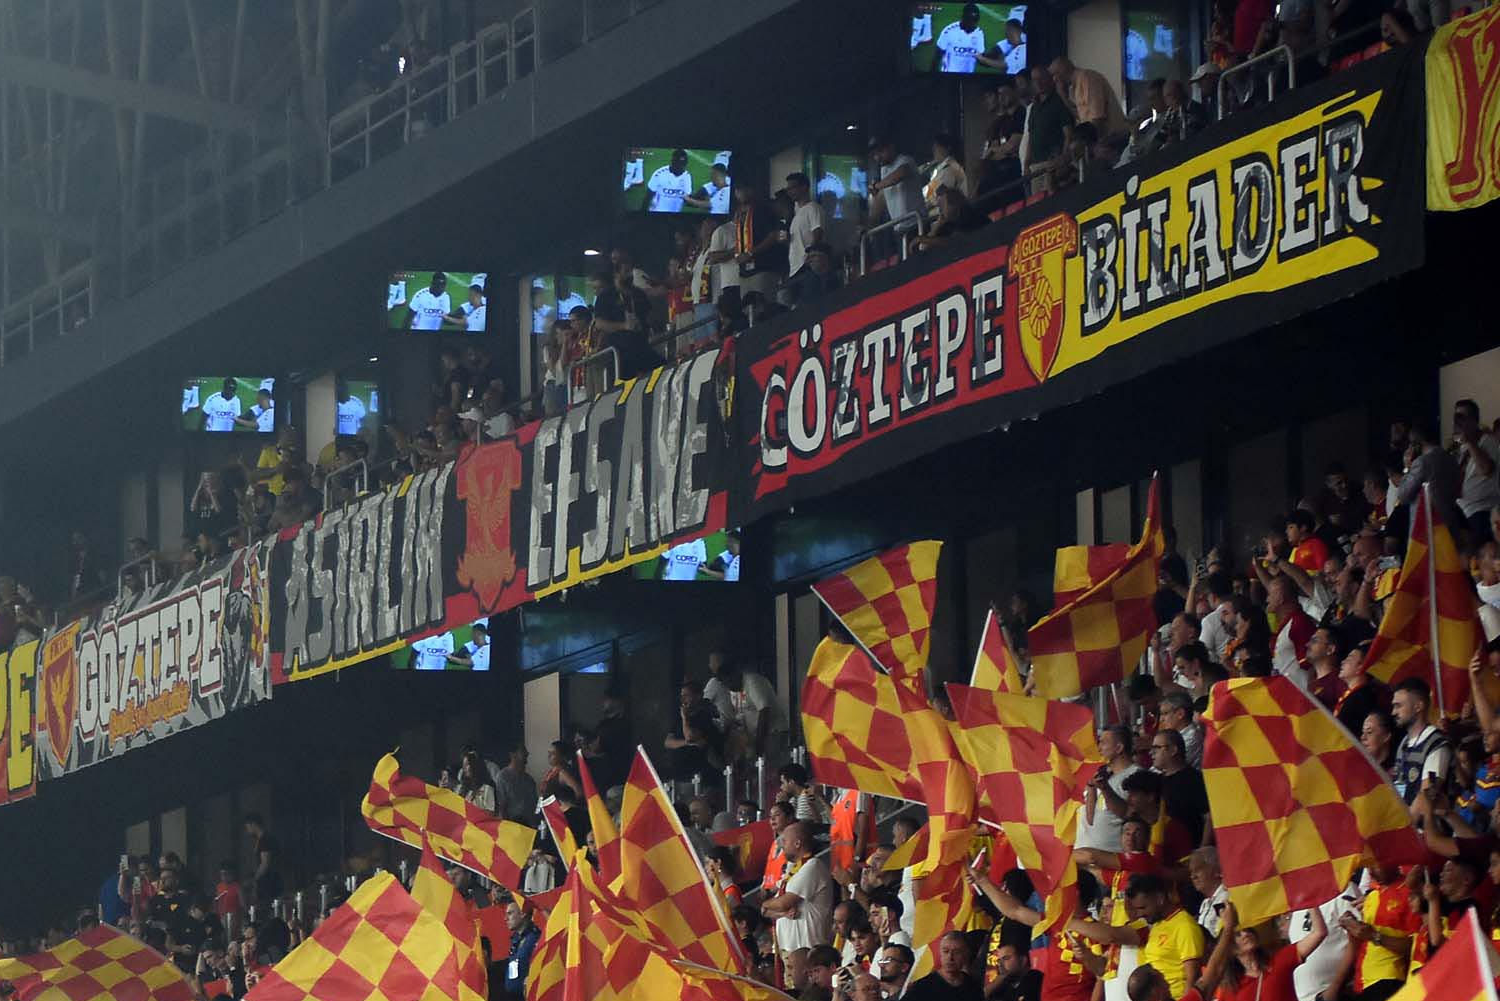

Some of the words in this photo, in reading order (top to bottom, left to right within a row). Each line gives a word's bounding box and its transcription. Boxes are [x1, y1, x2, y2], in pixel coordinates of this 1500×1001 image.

[760, 322, 1005, 466] GÖZTEPE
[1082, 120, 1370, 329] BİLADER
[527, 347, 720, 588] EFSANE
